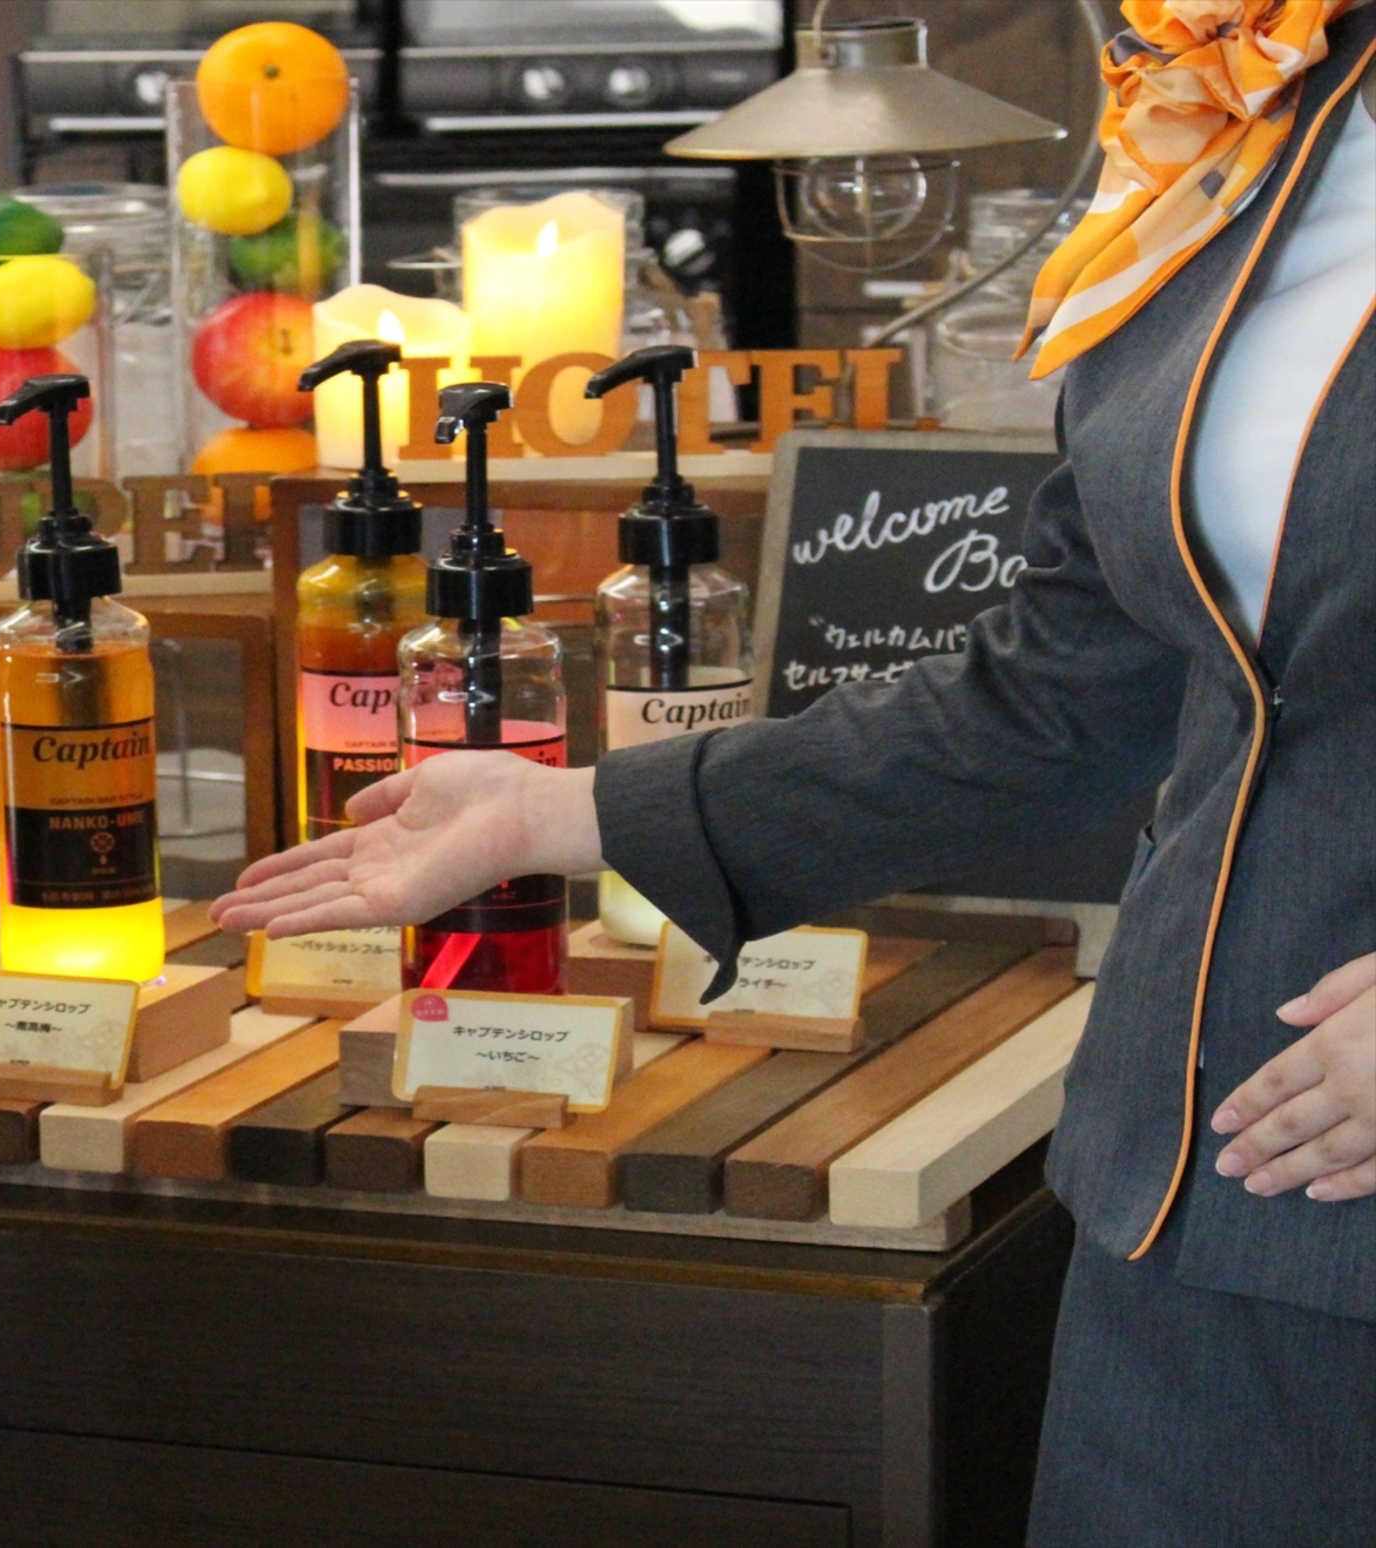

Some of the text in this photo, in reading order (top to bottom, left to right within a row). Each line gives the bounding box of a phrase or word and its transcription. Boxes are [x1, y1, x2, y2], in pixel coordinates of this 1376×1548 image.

[398, 348, 941, 461] HOTEL
[792, 486, 1010, 565] welcome
[32, 731, 150, 770] Captain
[453, 1025, 569, 1042] キャプテンシロップ
